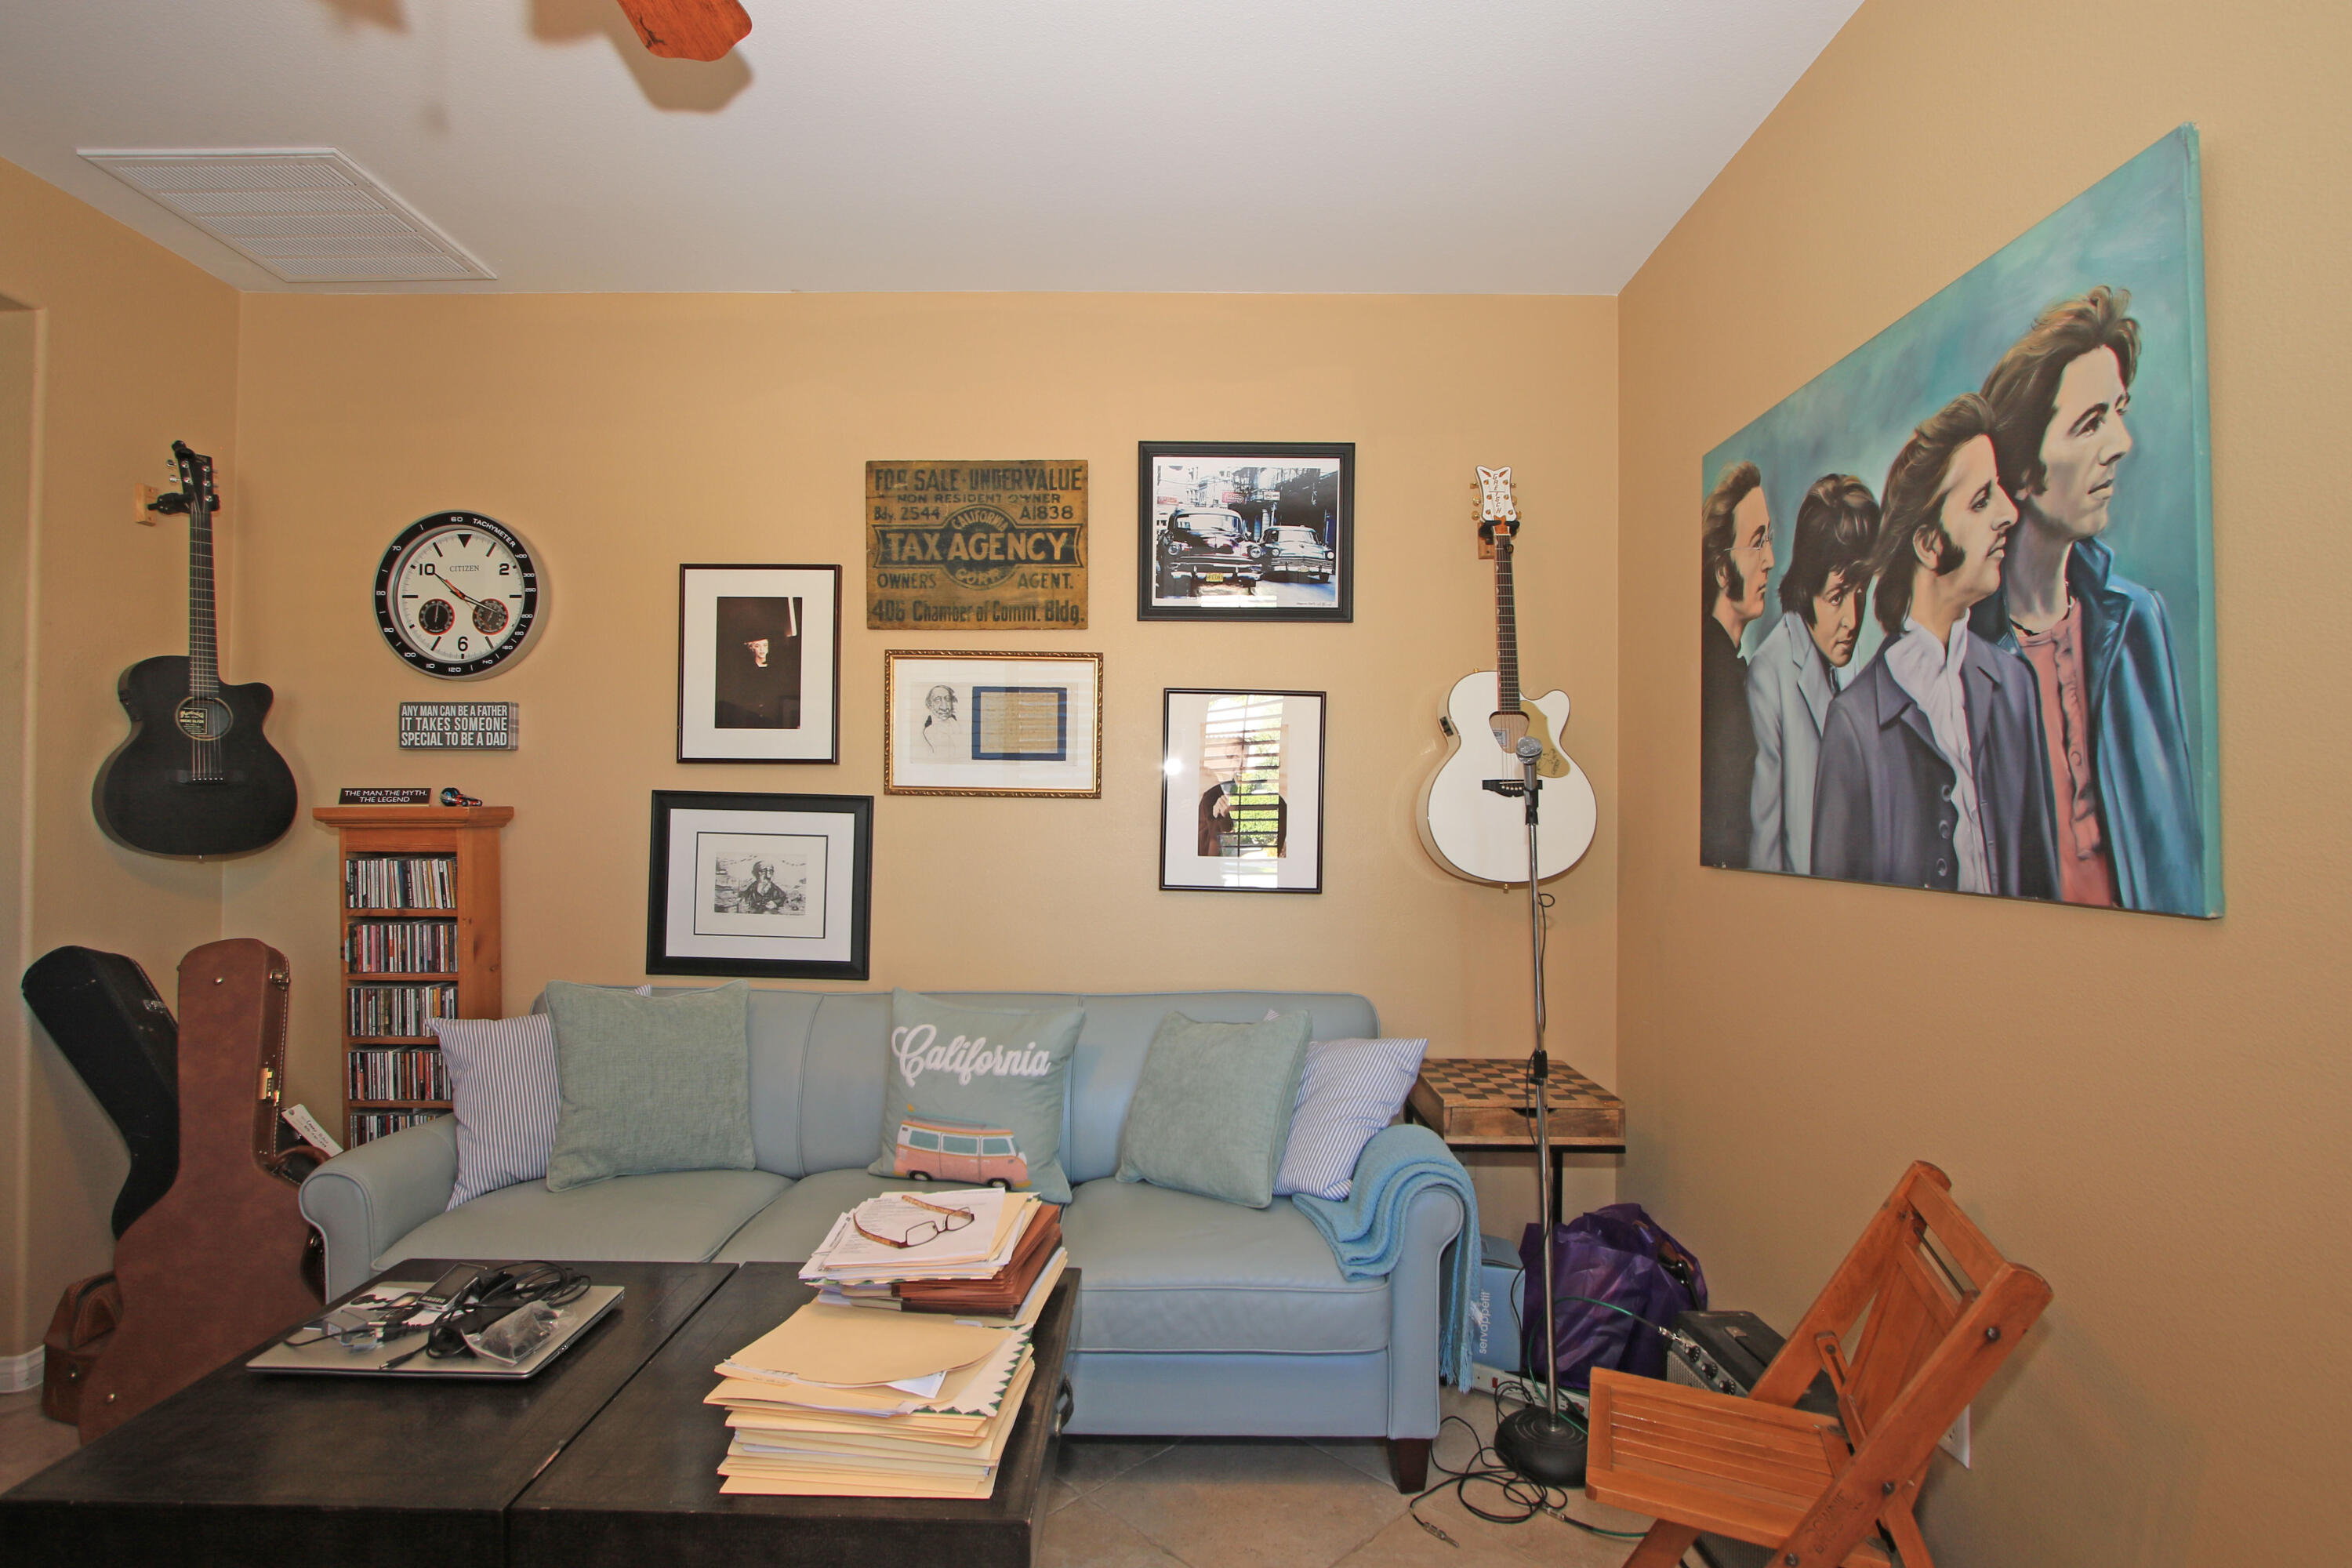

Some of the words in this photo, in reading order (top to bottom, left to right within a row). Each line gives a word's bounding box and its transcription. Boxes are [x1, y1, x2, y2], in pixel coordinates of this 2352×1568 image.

[874, 469, 908, 491] FOR
[914, 469, 960, 492] SALE
[969, 467, 1082, 492] UNDERVALUE
[897, 493, 927, 503] NON
[935, 493, 1001, 503] RESIDENT
[1007, 493, 1061, 503] OWNER
[1493, 473, 1502, 514] GRETSCH
[900, 506, 941, 520] 2544
[952, 510, 1009, 532] CALIFORNIA
[472, 517, 517, 548] TACHYMETER
[886, 532, 943, 561] TAX
[947, 532, 1069, 561] AGENCY
[419, 563, 436, 576] 10
[499, 563, 510, 575] 2
[871, 599, 906, 622] 406
[913, 599, 972, 622] Chamber
[976, 600, 990, 622] of
[457, 636, 469, 652] 6
[401, 705, 419, 717] ANY
[420, 705, 438, 717] MAN
[440, 705, 456, 717] CAN
[458, 705, 469, 717] BE
[470, 705, 476, 717] A
[477, 705, 507, 717] FATHER
[401, 717, 412, 731] IT
[416, 717, 451, 731] TAKES
[455, 717, 507, 731] SOMEONE
[401, 732, 444, 746] SPECIAL
[445, 732, 459, 746] TO
[461, 732, 474, 746] BE
[476, 732, 484, 746] A
[486, 732, 507, 746] DAD
[891, 1023, 1051, 1088] California
